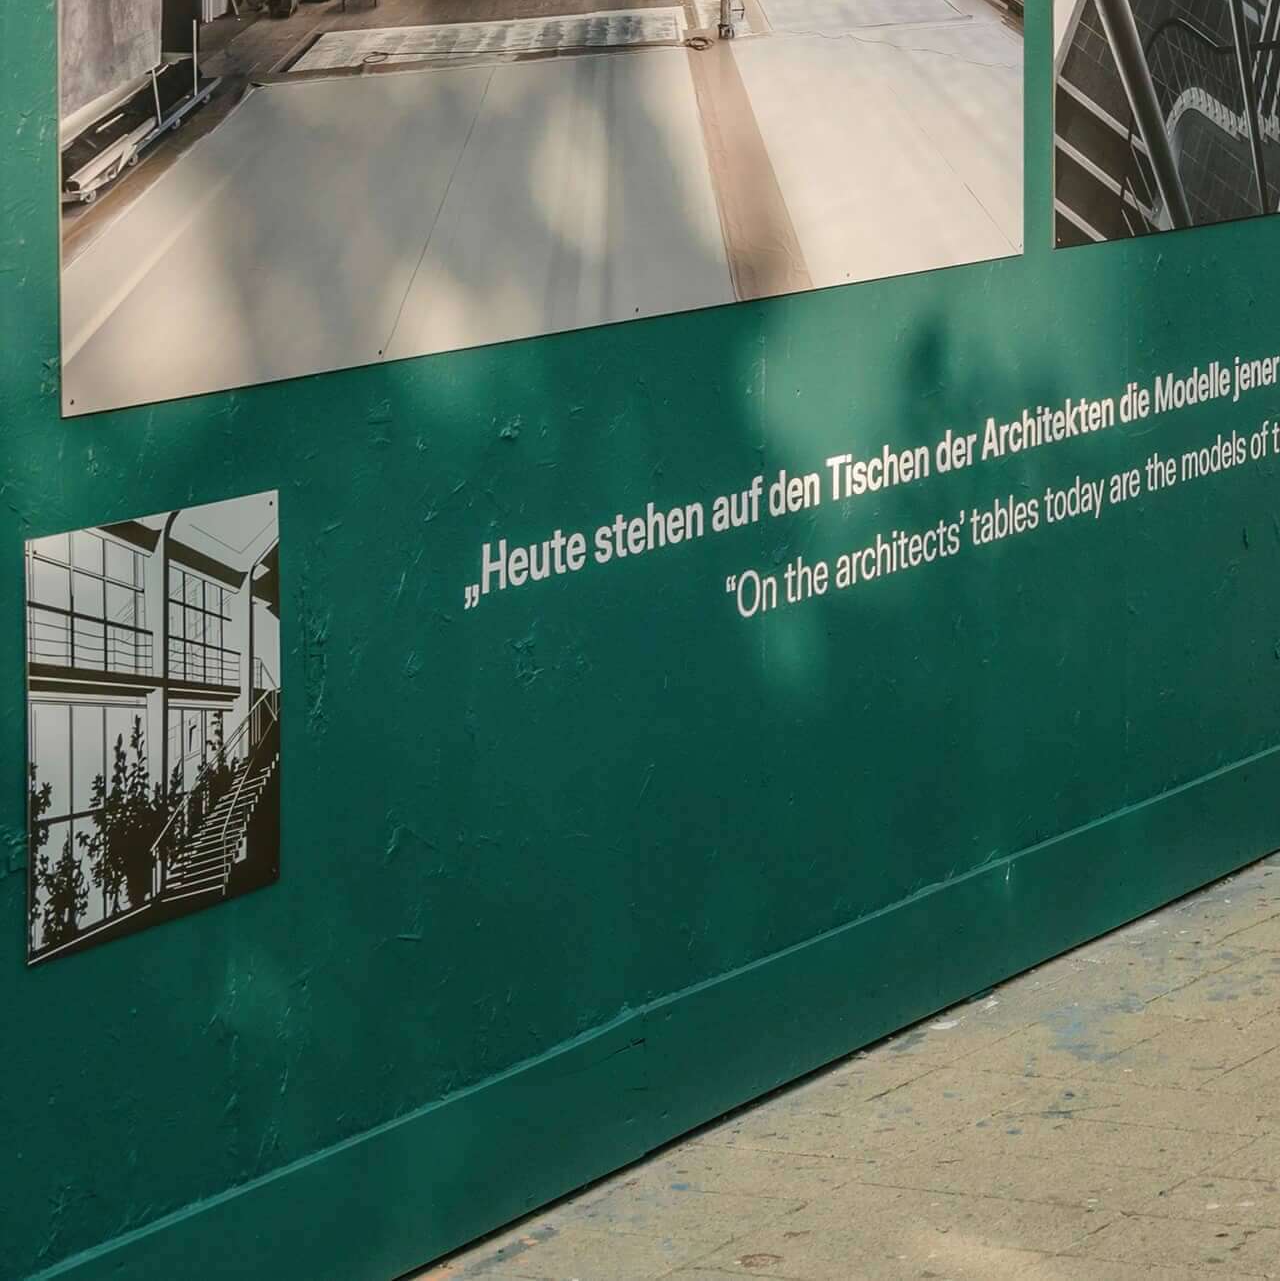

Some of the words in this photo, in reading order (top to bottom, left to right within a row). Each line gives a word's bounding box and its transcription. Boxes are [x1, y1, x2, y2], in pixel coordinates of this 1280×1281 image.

[464, 529, 586, 609] „Heute
[594, 502, 704, 564] stehen
[712, 475, 763, 532] auf
[769, 469, 820, 517] den
[826, 445, 929, 500] Tischen
[936, 429, 977, 473] der
[981, 397, 1114, 461] Architekten
[1120, 381, 1149, 424] die
[1154, 361, 1231, 414] Modelle
[1233, 356, 1280, 402] jener
[784, 556, 829, 603] the
[970, 494, 1040, 546] tables
[1044, 475, 1105, 523] today
[1109, 468, 1141, 504] are
[1145, 453, 1177, 491] the
[1181, 429, 1246, 481] models
[1250, 420, 1269, 460] of
